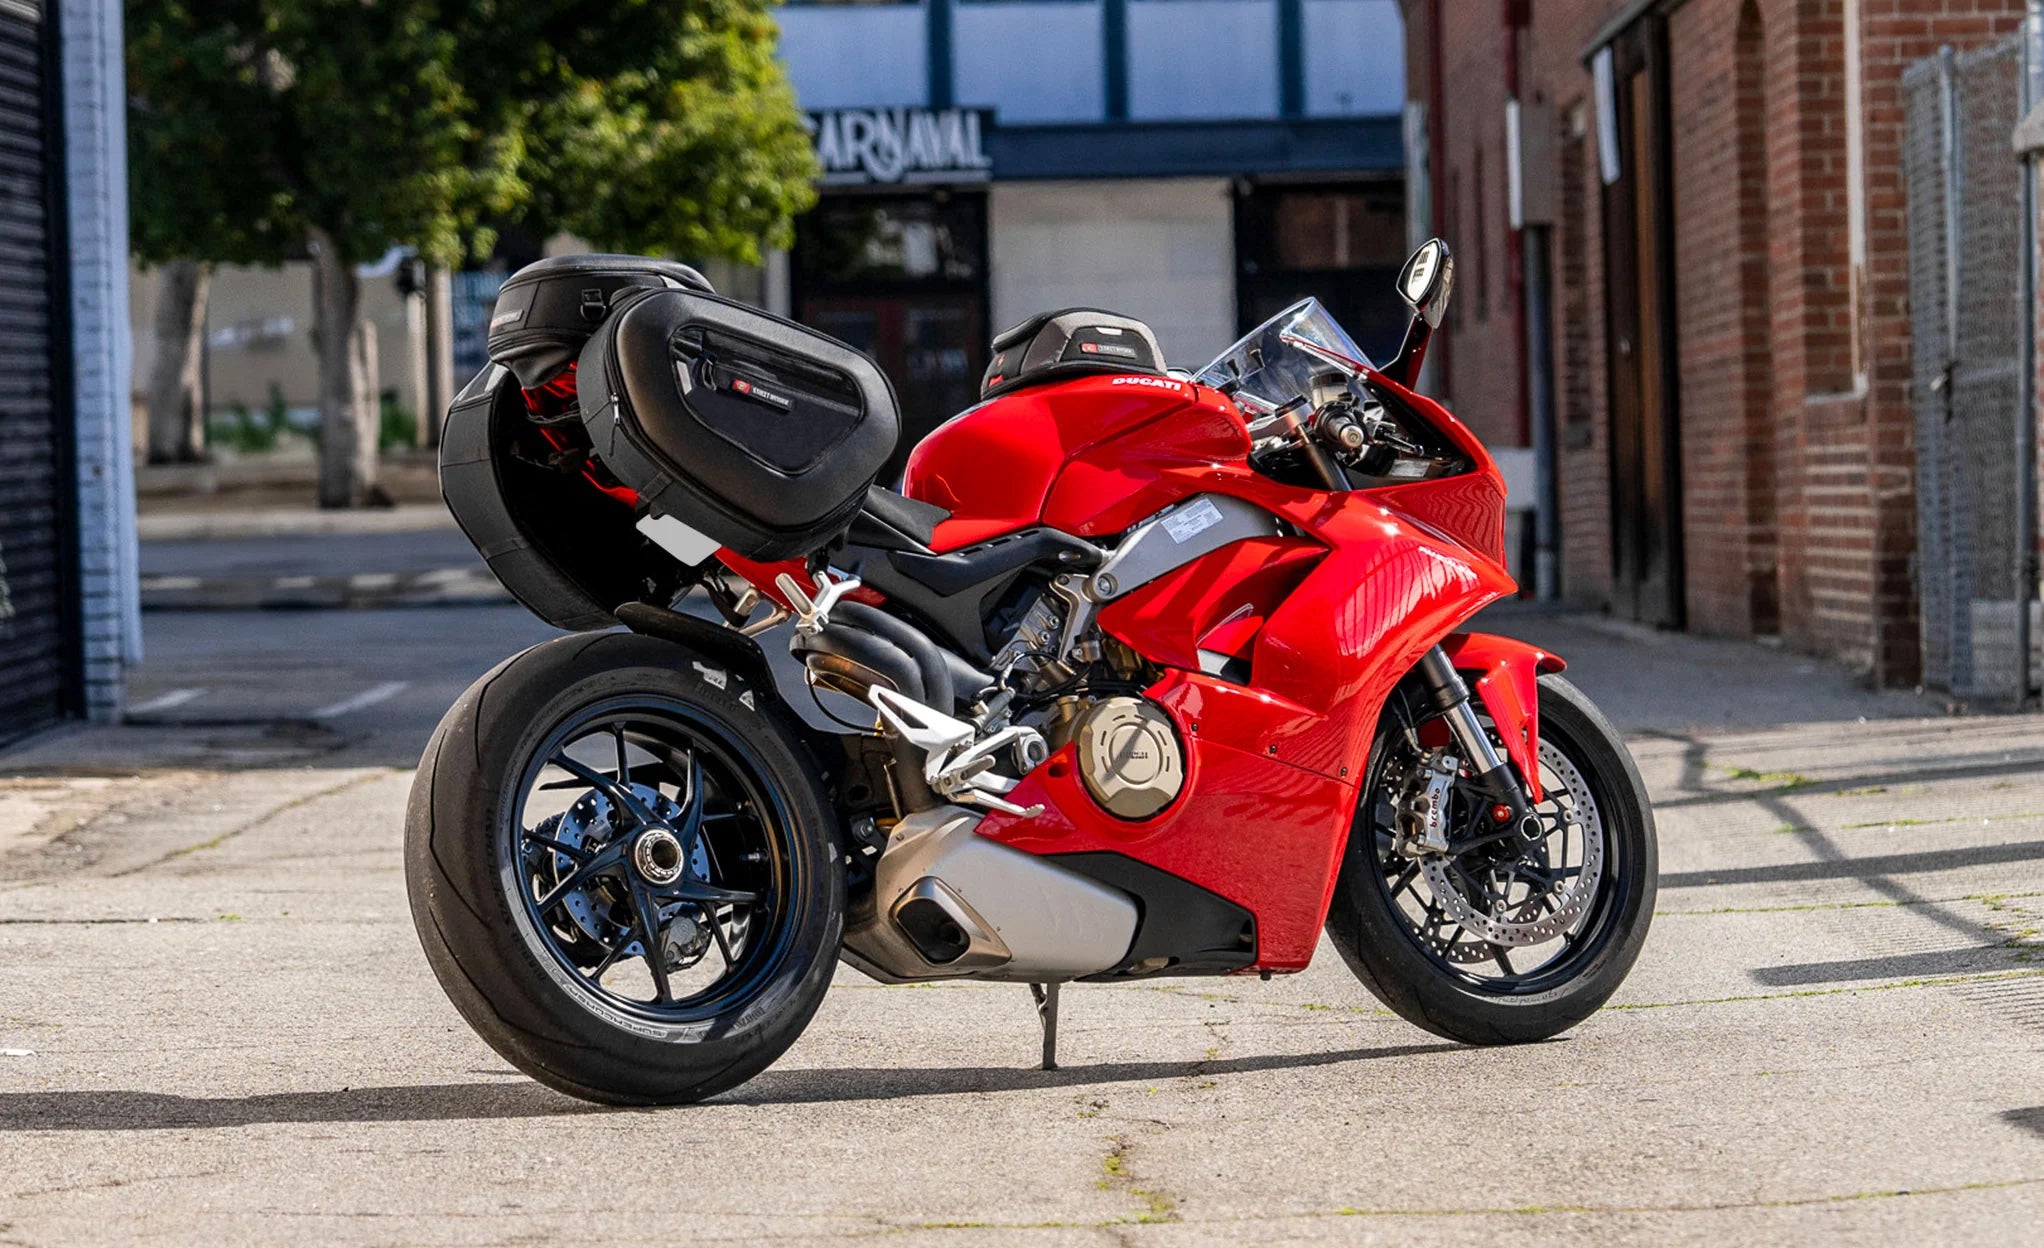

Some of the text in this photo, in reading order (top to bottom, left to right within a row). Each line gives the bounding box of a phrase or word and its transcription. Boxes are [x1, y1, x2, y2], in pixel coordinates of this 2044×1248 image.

[802, 107, 993, 182] ARNAVAL
[1111, 377, 1182, 391] DUCATI
[1429, 787, 1441, 828] brembo
